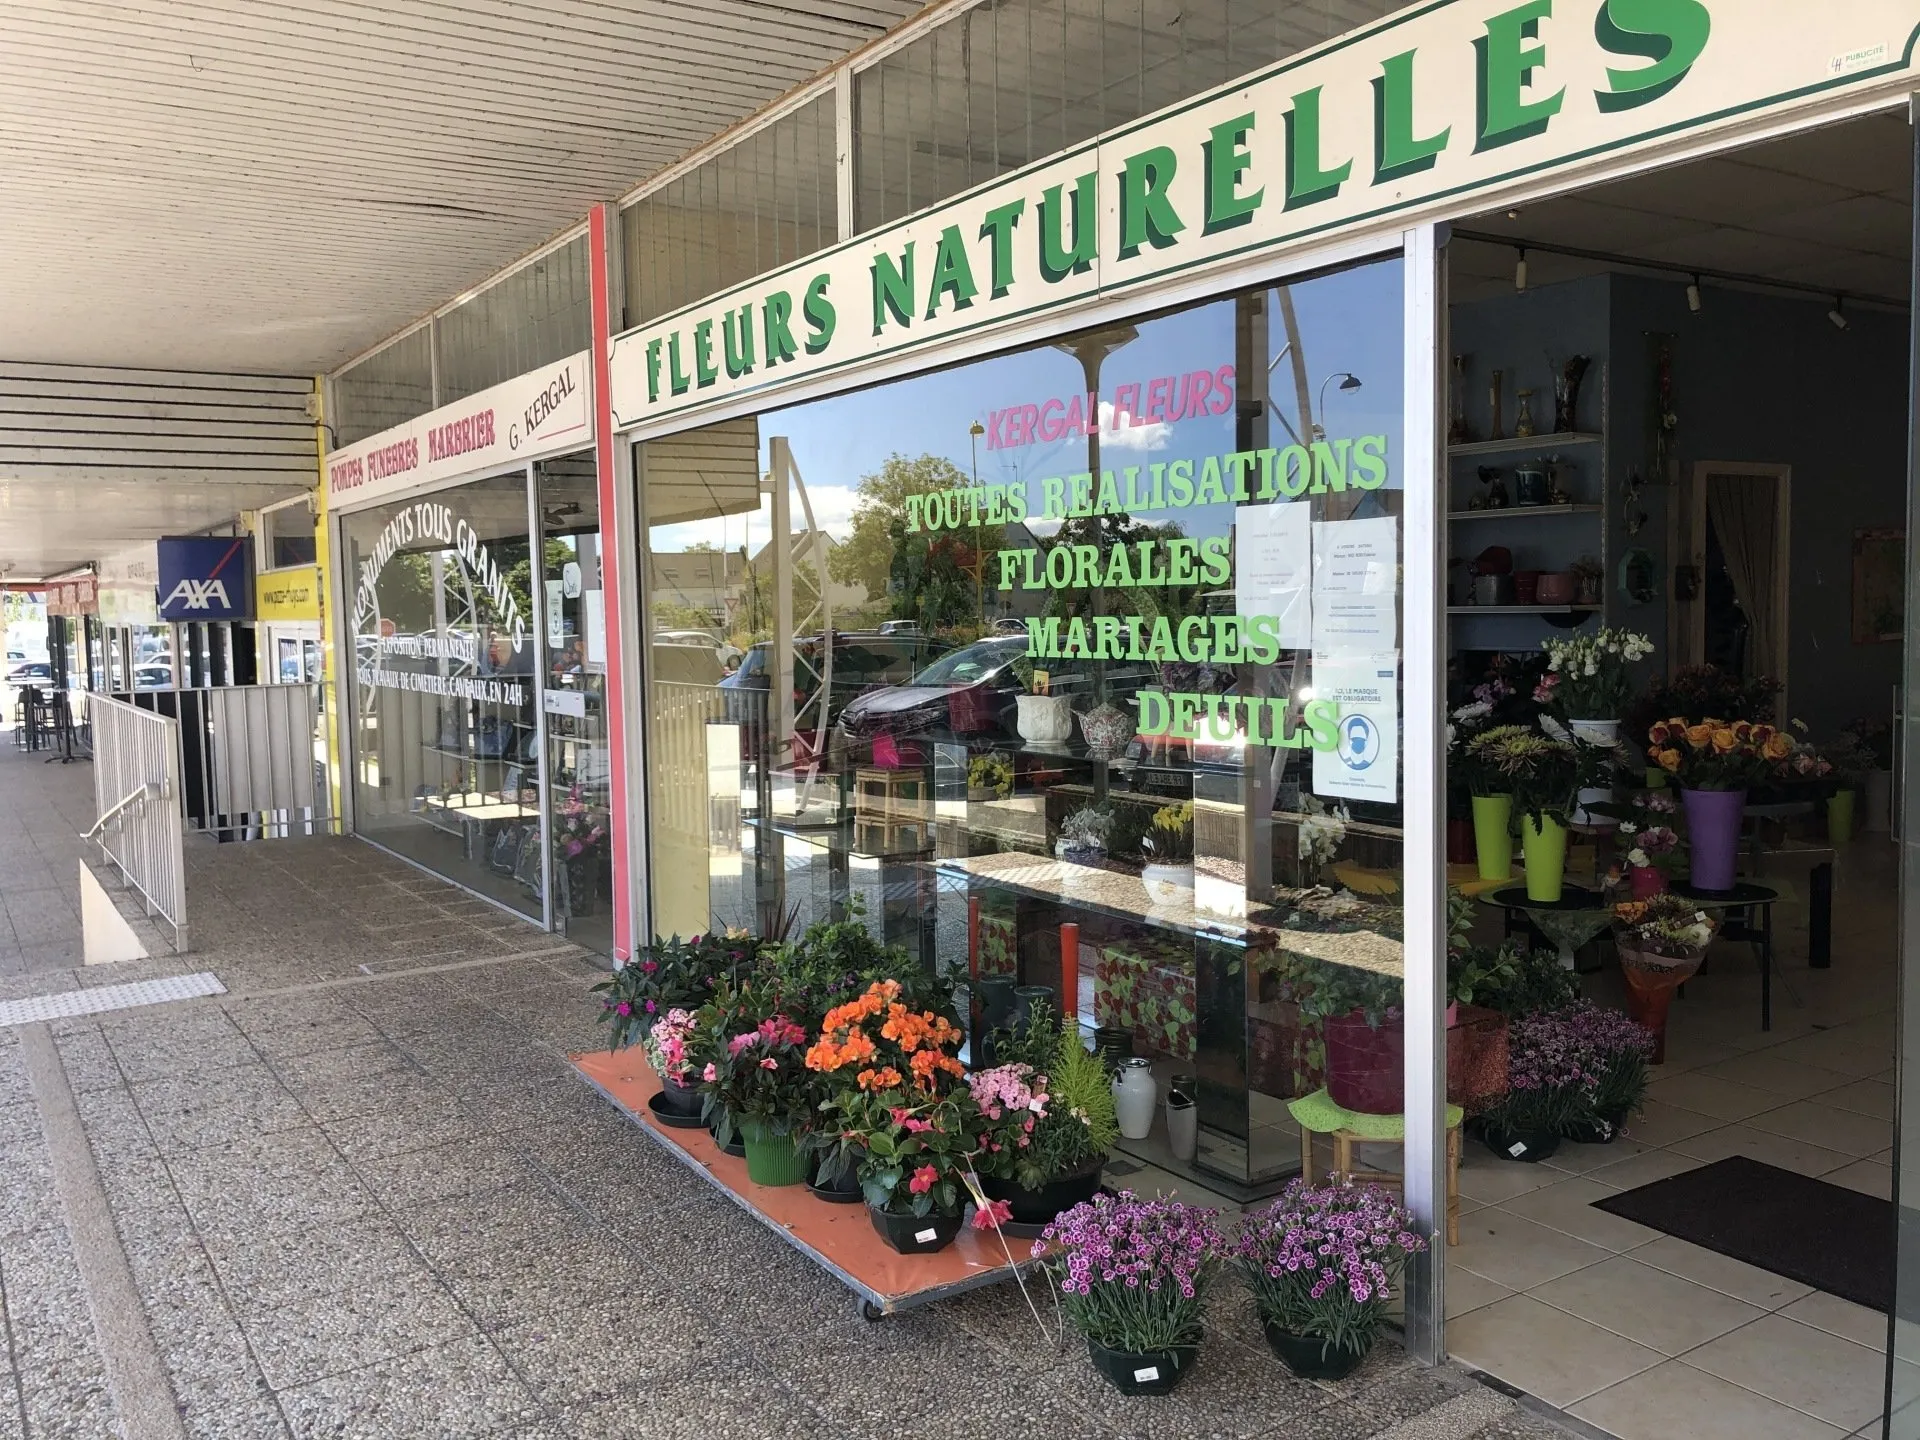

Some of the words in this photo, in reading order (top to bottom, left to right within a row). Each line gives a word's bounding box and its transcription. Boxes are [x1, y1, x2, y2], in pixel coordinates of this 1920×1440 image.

[645, 273, 837, 403] FLEURS
[871, 0, 1711, 336] NATURELLES
[509, 423, 523, 450] G.
[524, 365, 576, 436] KERGAL
[987, 391, 1099, 450] KERGAL
[1112, 364, 1237, 430] FLEURS
[331, 457, 364, 493] POMPES
[367, 437, 419, 482] FUNEBRES
[428, 408, 496, 463] MARBRIER
[905, 482, 1028, 532] TOUTES
[1041, 435, 1388, 520] REALISATIONS
[161, 579, 233, 610] AXA
[350, 506, 414, 638] MONUMENTS
[414, 502, 452, 544] TOUS
[456, 518, 526, 655] GRANITS
[997, 536, 1231, 591] FLORALES
[383, 637, 421, 656] EXPOSITION
[425, 637, 475, 660] PERMANENTE
[1025, 615, 1280, 665] MARIAGES
[372, 669, 400, 689] TRAVAUX
[400, 671, 410, 690] DE
[503, 682, 523, 706] 24H
[1353, 688, 1378, 696] MASQUE
[1136, 690, 1340, 752] DEUILS
